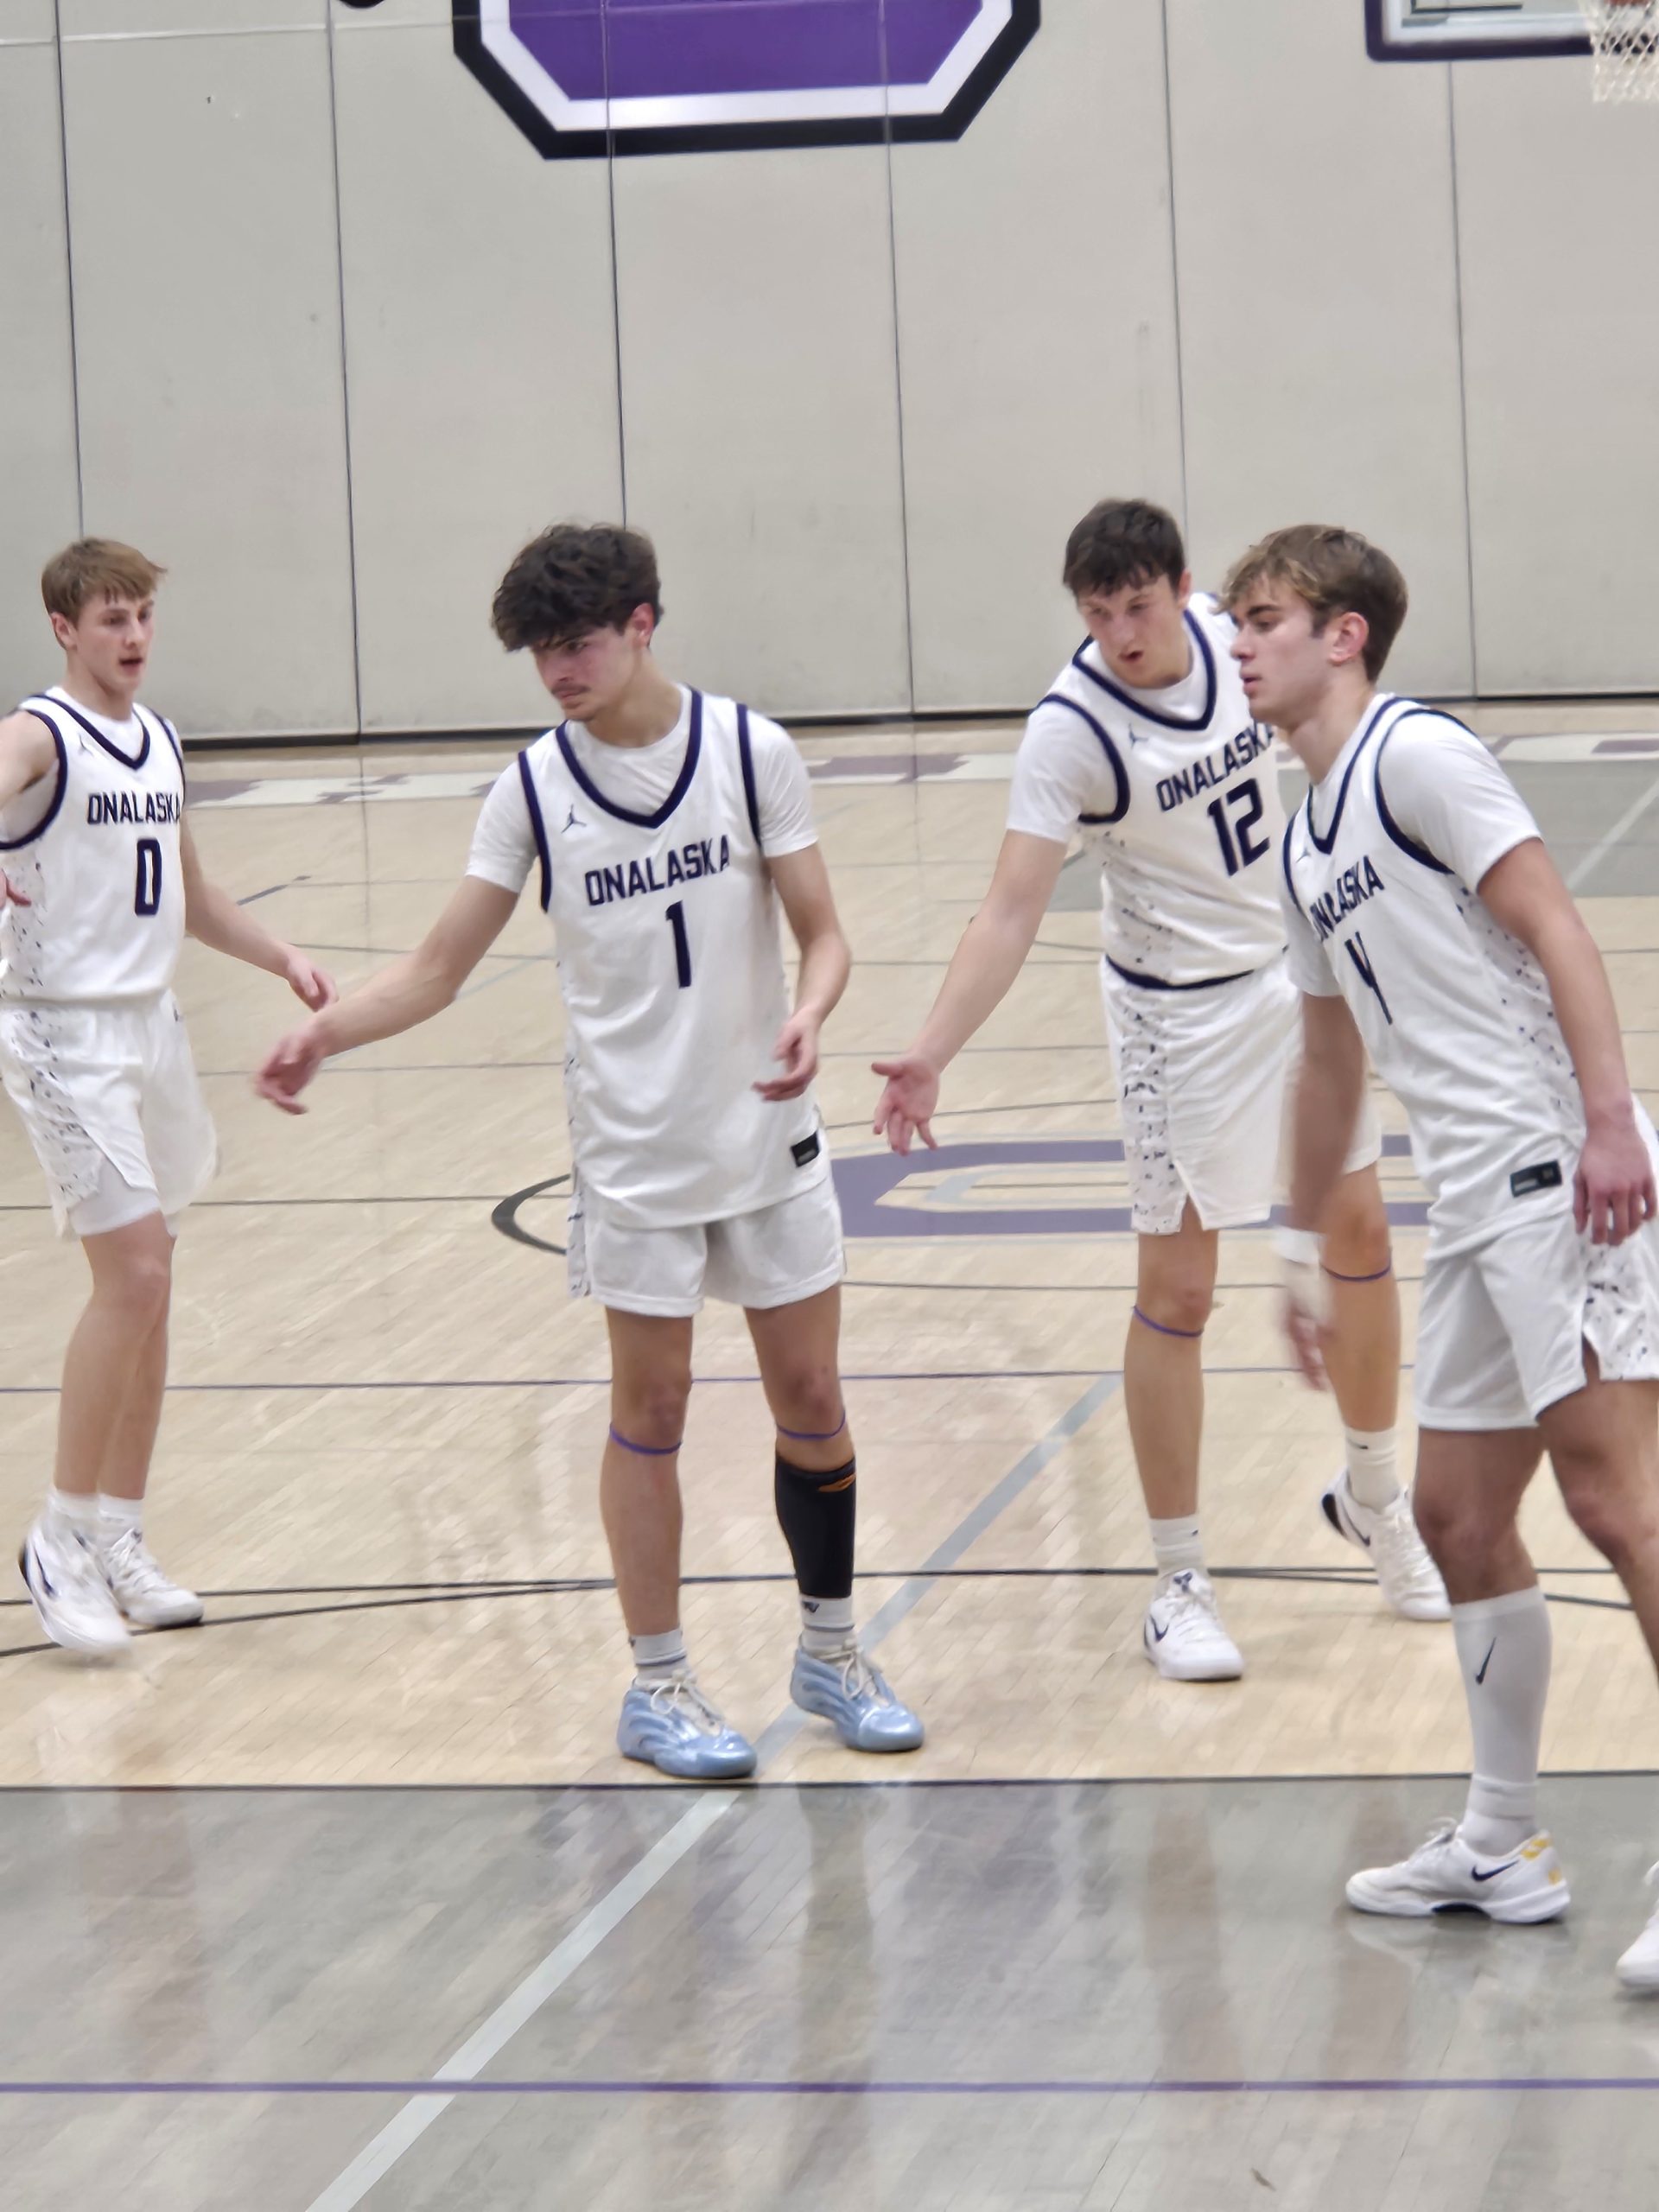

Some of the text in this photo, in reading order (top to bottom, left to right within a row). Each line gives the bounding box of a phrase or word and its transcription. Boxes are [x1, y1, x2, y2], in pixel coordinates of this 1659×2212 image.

[87, 791, 181, 824] ONALASKA
[1206, 778, 1270, 876] 12
[135, 838, 162, 917] 0
[585, 835, 730, 906] ONALASKA
[665, 899, 691, 988] 1
